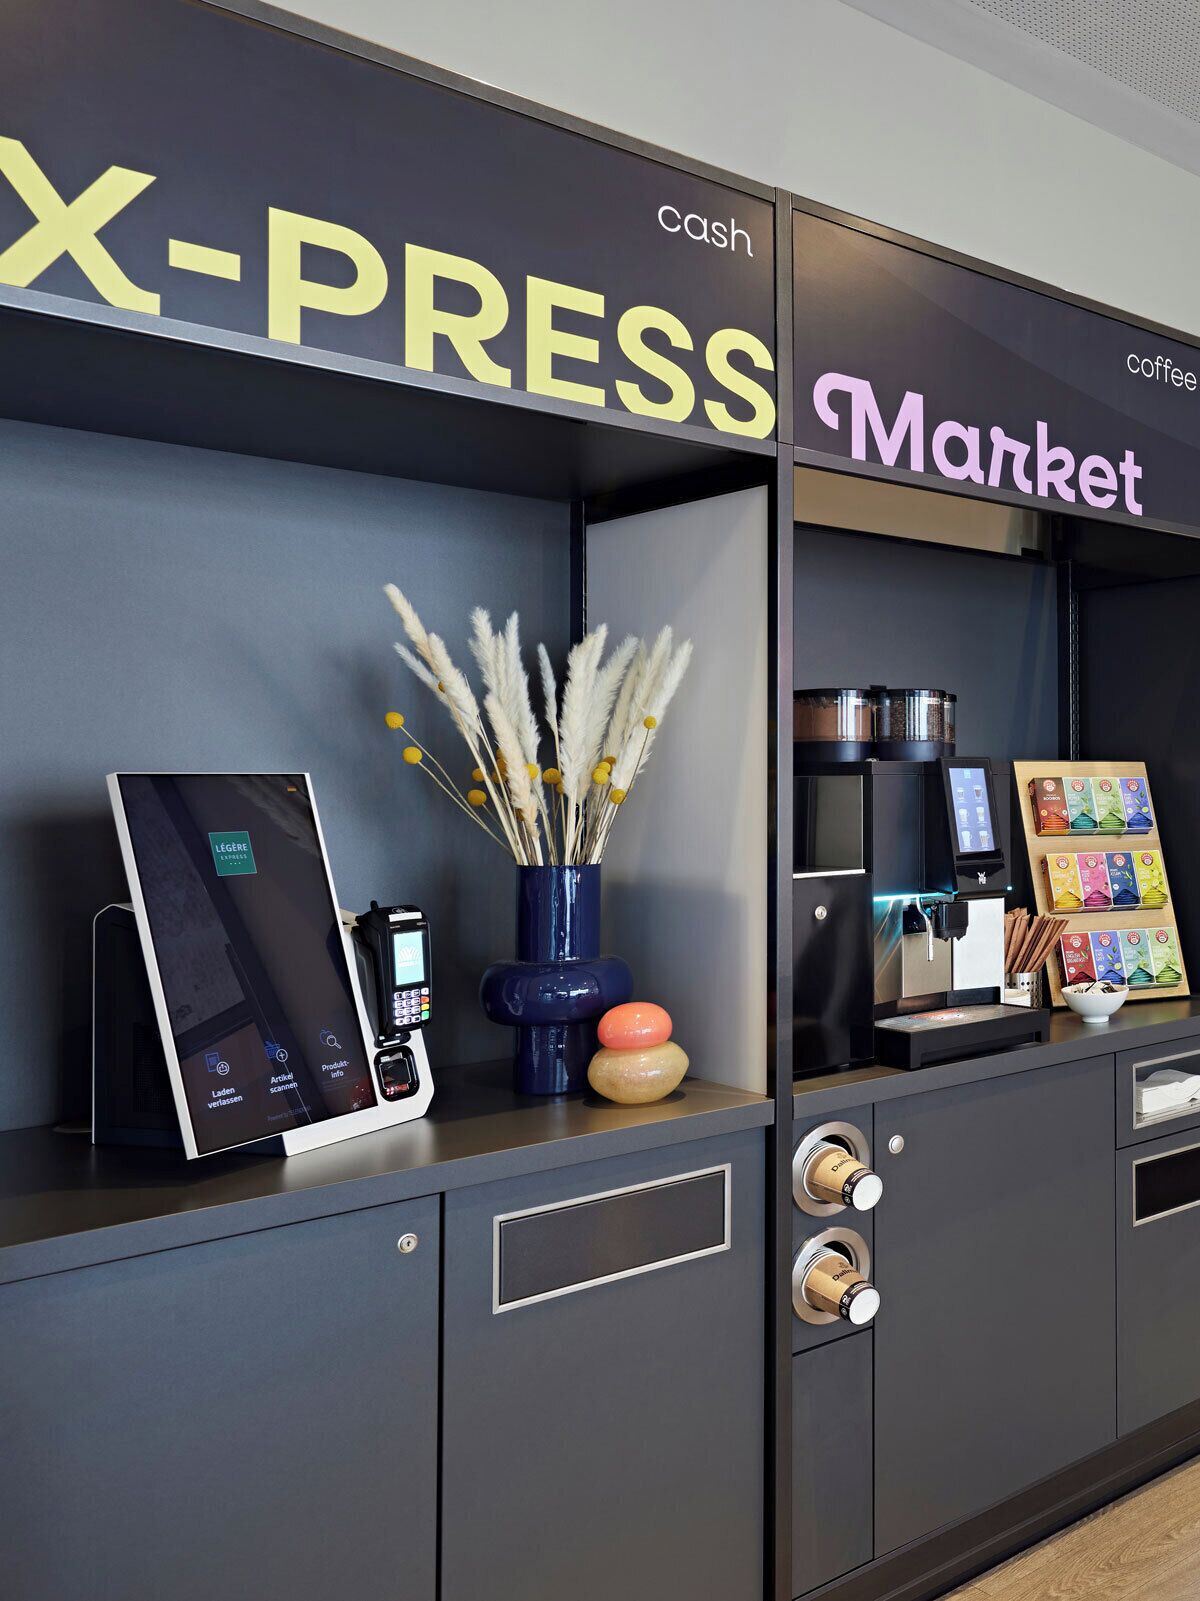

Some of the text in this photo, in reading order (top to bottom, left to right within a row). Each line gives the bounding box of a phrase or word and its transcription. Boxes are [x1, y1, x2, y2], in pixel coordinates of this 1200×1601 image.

[657, 205, 754, 258] cash
[0, 135, 777, 440] X-PRESS
[1126, 353, 1197, 391] coffee
[813, 372, 1143, 516] Market
[215, 842, 249, 853] LÉGÈRE
[321, 1060, 350, 1072] Produkt-
[270, 1072, 294, 1085] Artikel
[330, 1070, 345, 1079] info
[211, 1087, 236, 1099] Laden
[269, 1081, 299, 1095] scannen
[207, 1094, 243, 1109] verlassen
